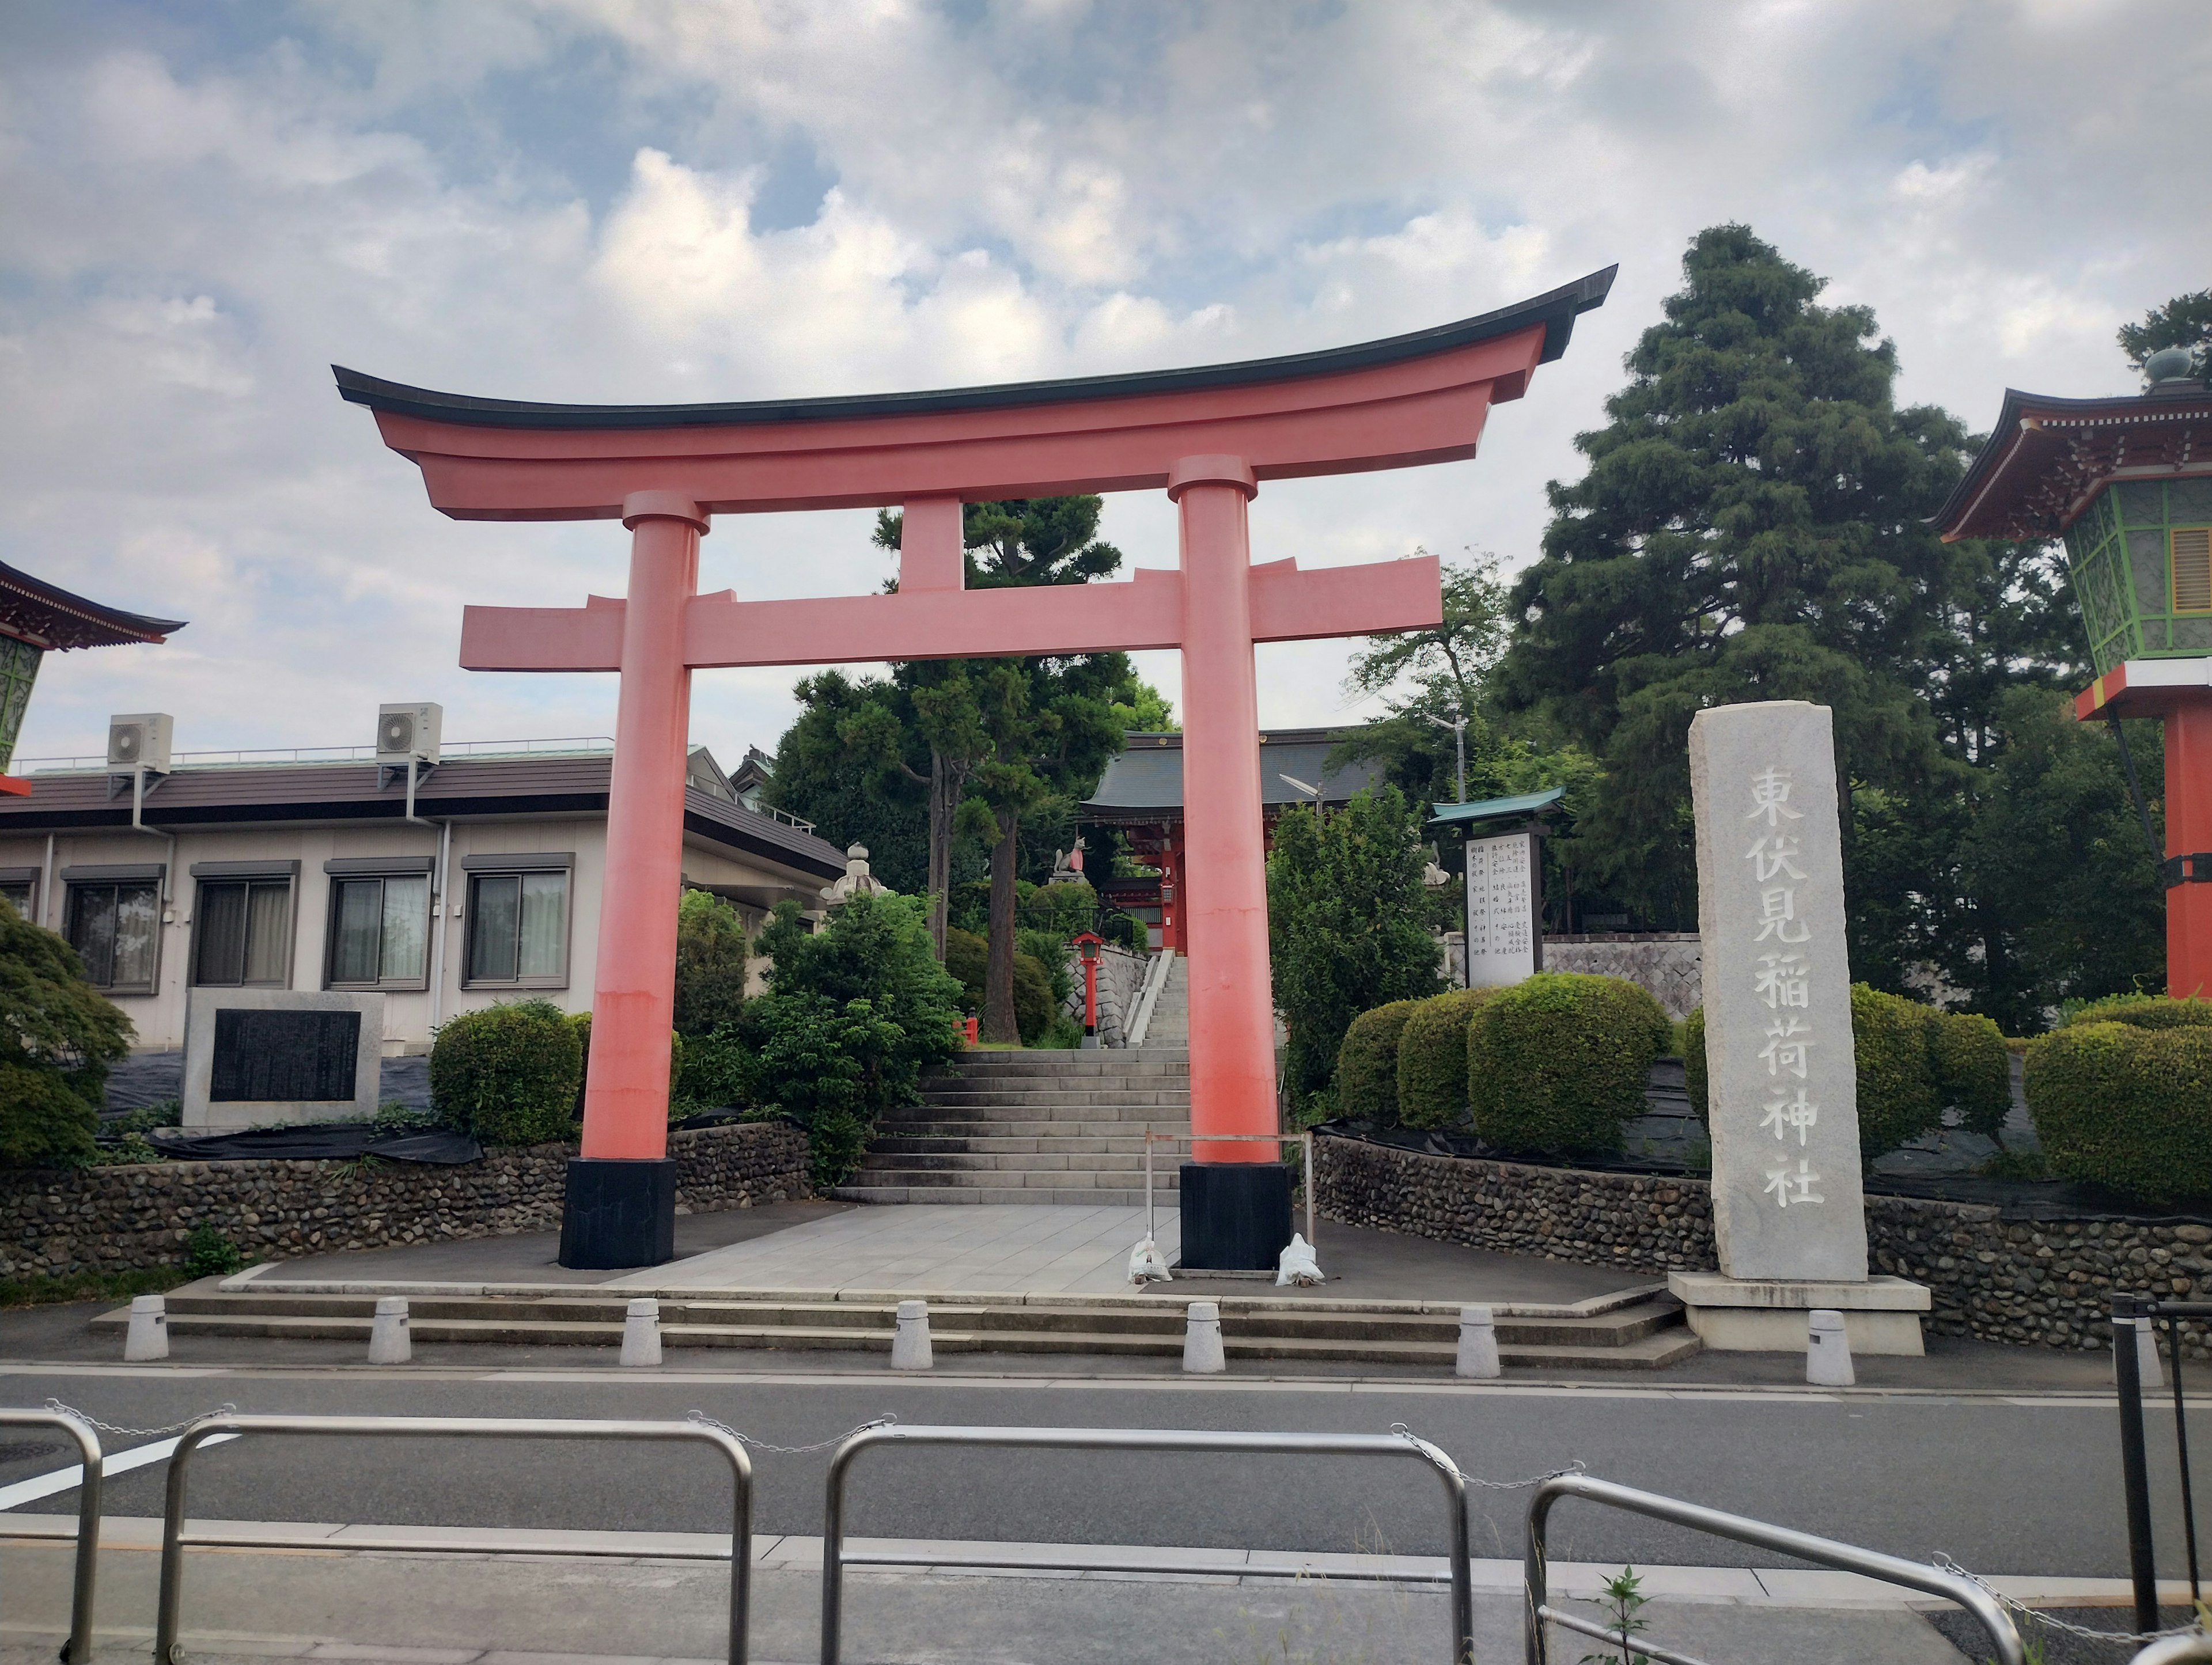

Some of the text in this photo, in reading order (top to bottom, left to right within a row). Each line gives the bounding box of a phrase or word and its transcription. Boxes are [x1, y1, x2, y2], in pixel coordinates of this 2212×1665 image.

[1744, 763, 1825, 1208] 東伏見稲荷神社
